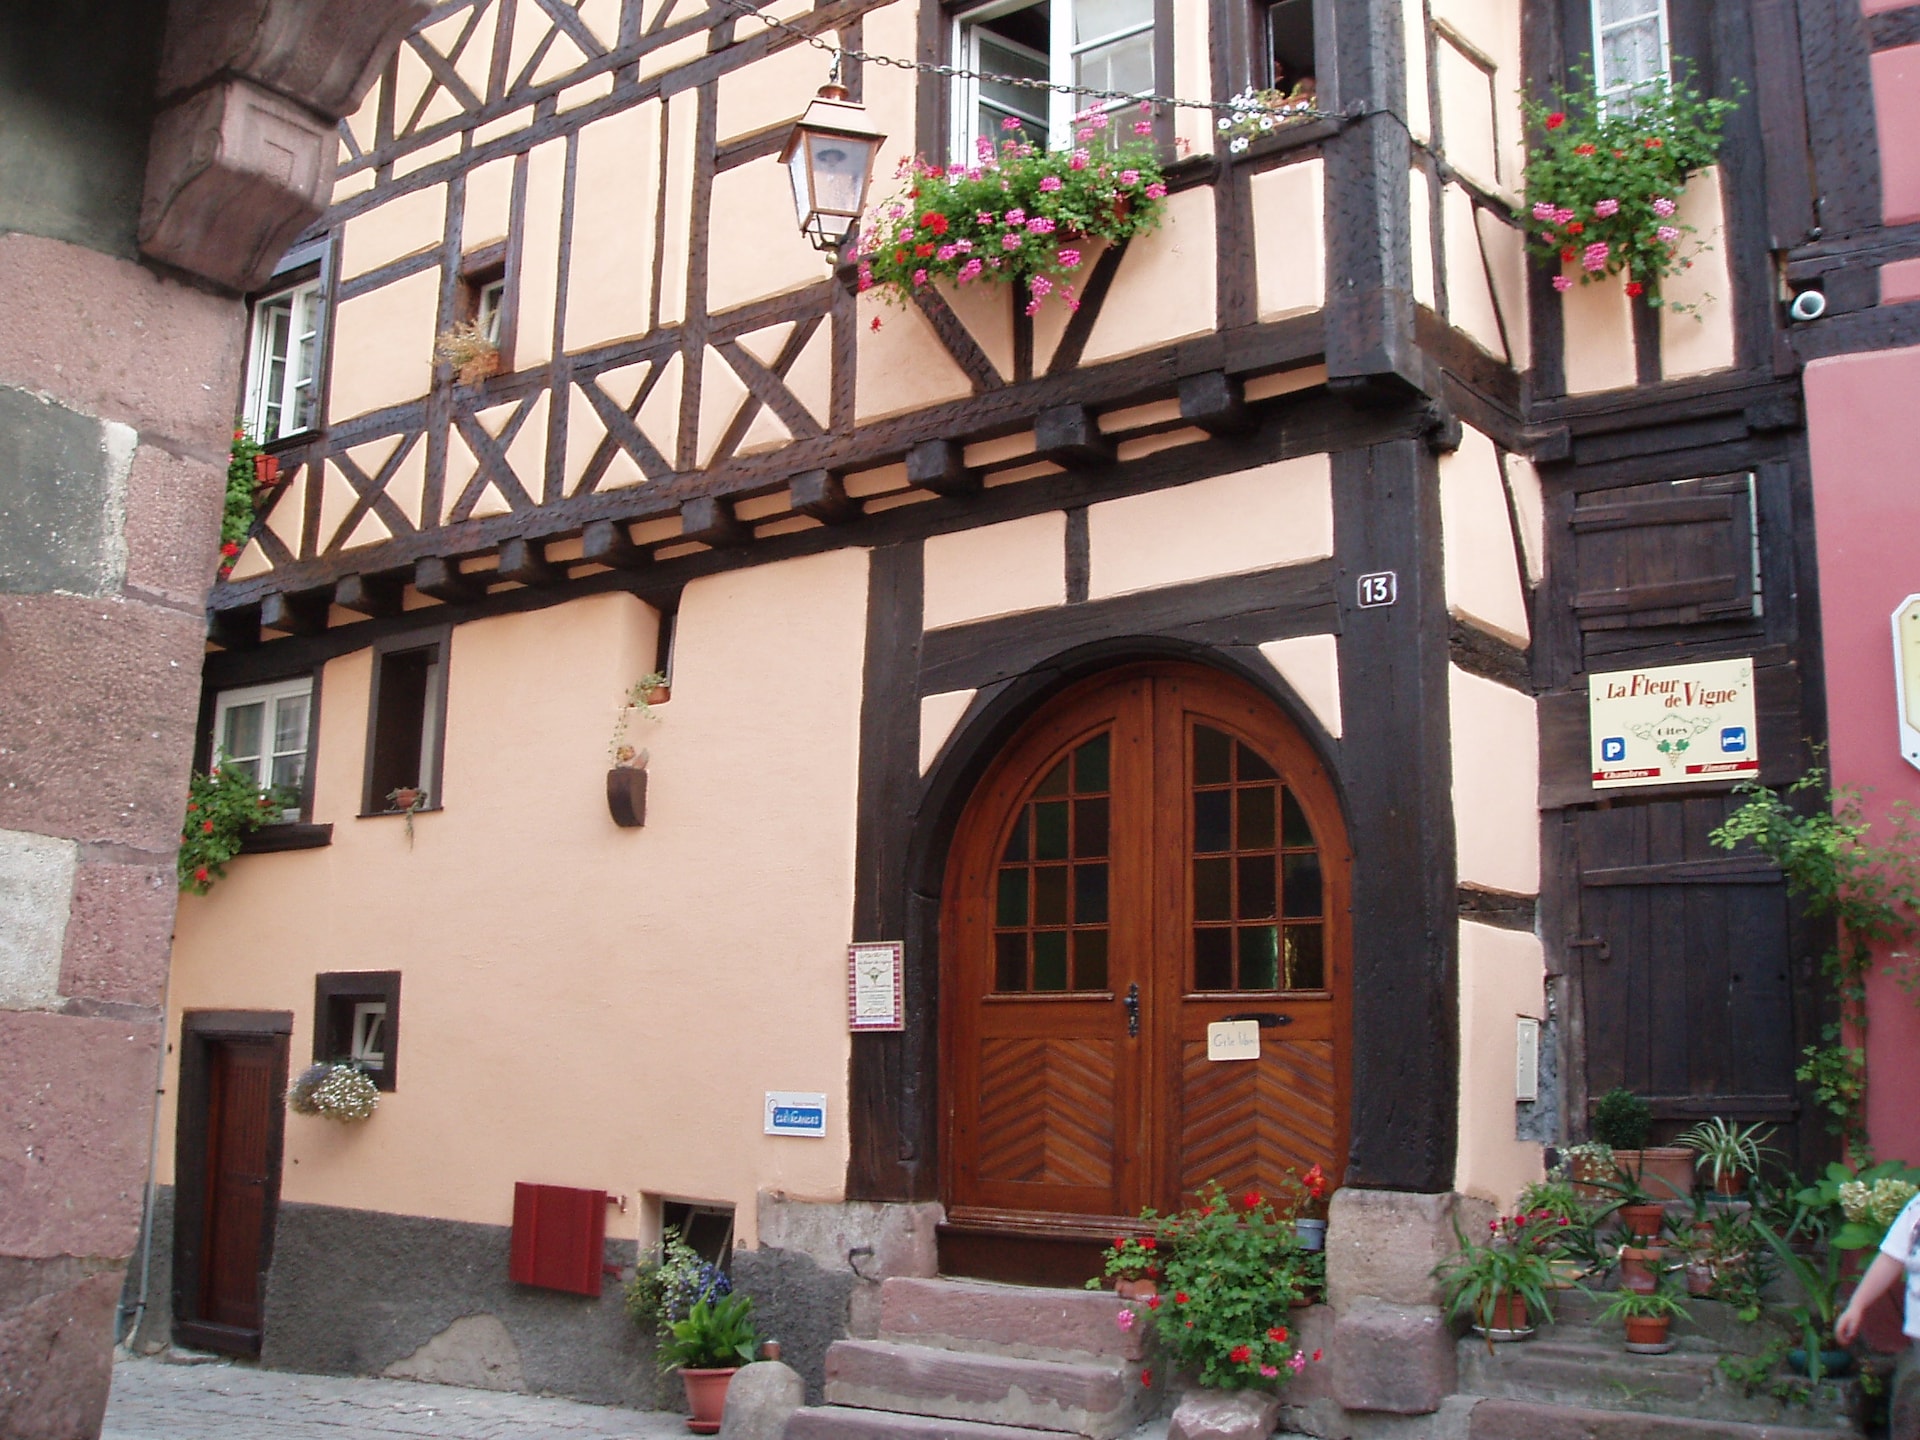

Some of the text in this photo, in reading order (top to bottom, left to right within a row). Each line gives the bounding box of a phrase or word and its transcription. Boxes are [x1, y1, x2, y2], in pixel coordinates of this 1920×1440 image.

[1363, 577, 1387, 602] 13
[1607, 674, 1680, 699] La Fleur
[1664, 681, 1737, 708] de Vigne
[1607, 742, 1621, 758] P
[1603, 769, 1649, 780] Chambres
[1701, 763, 1739, 772] Zimmer
